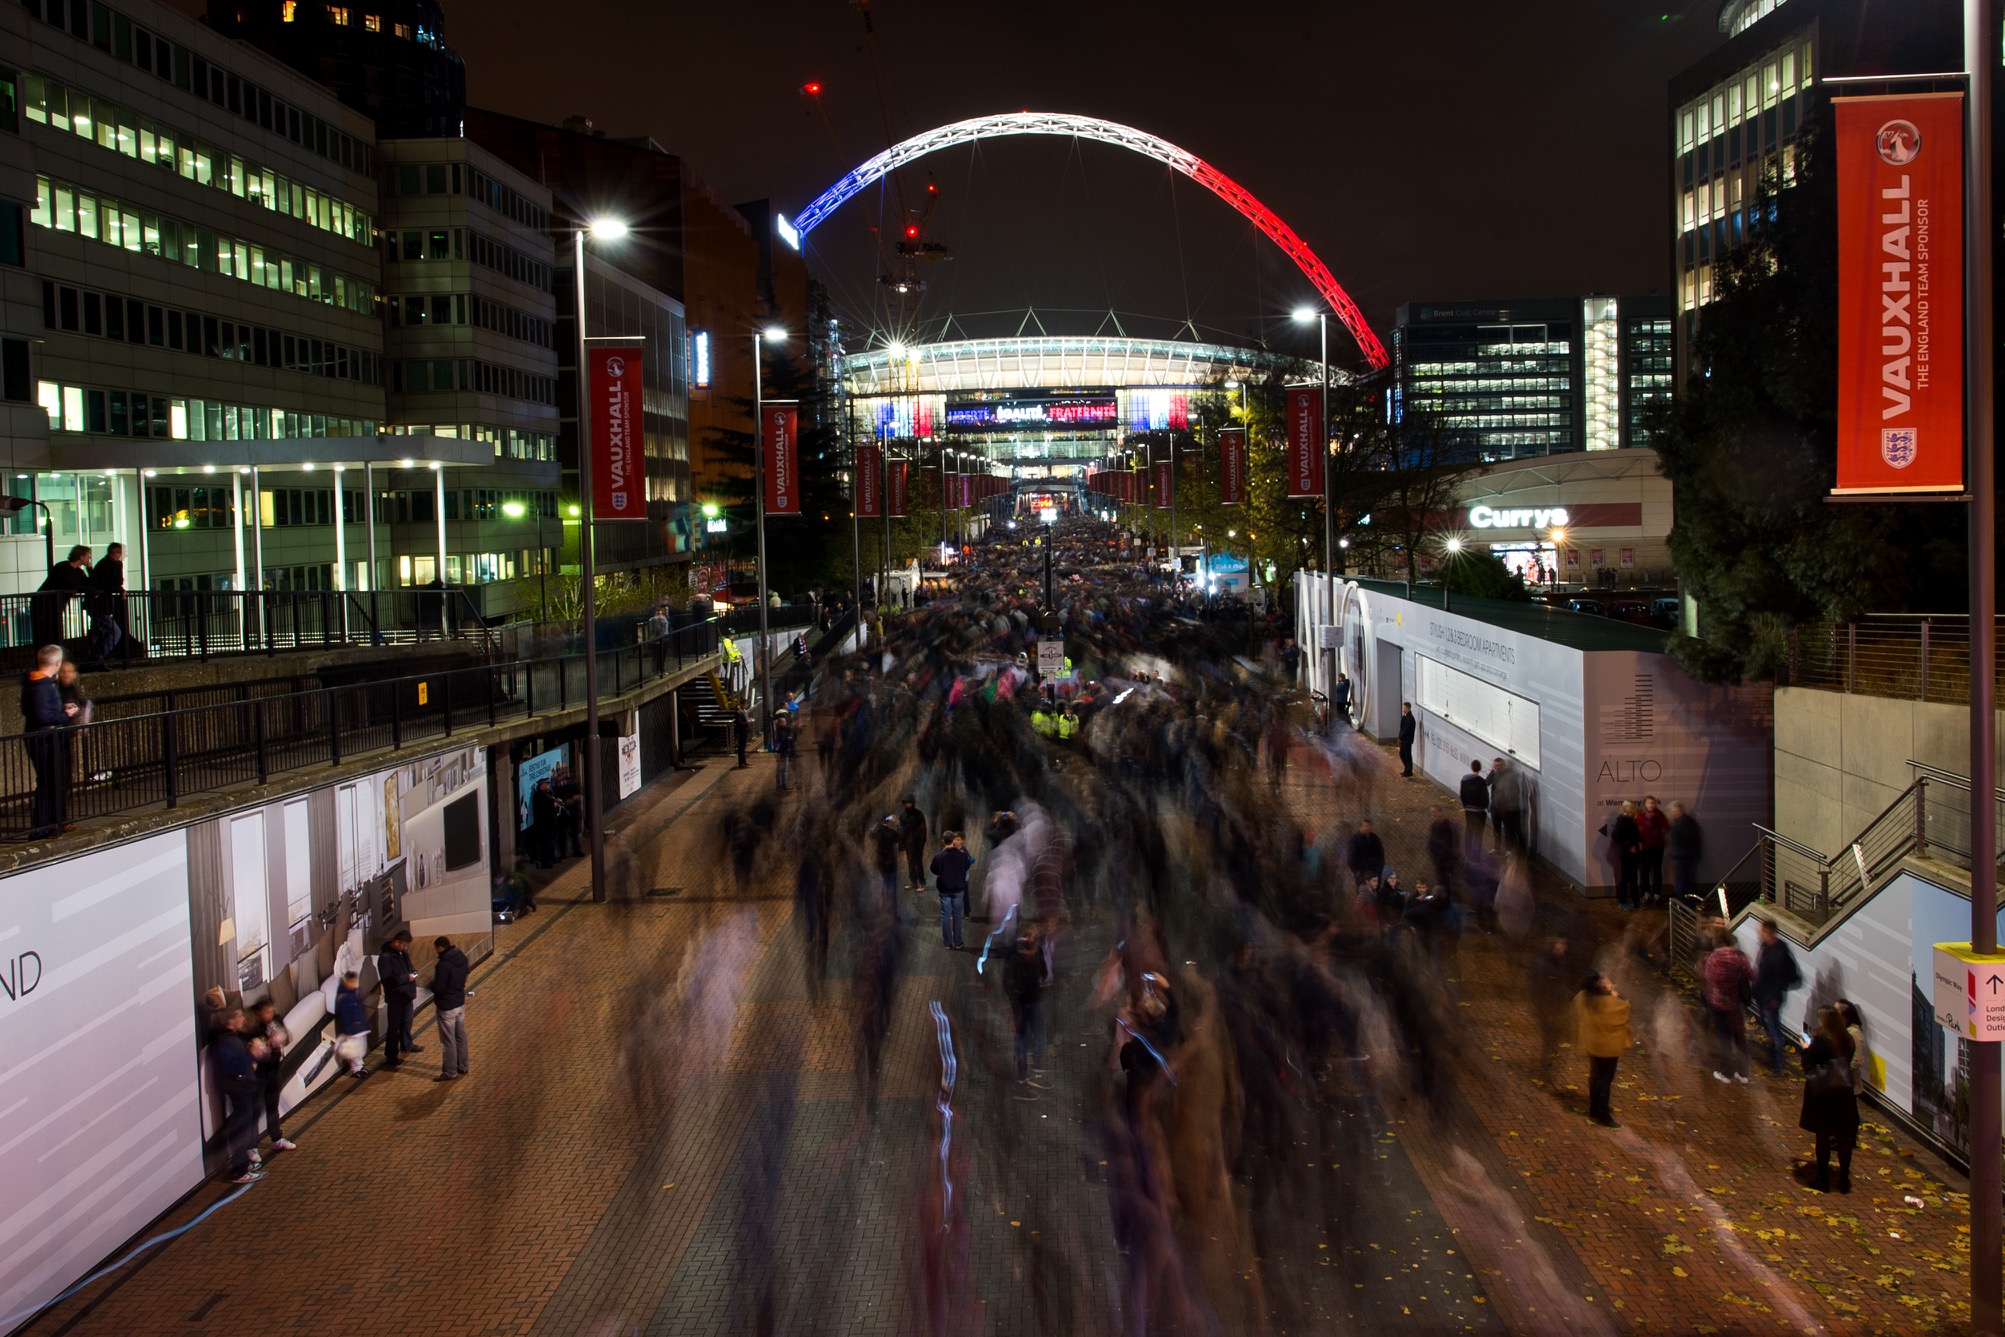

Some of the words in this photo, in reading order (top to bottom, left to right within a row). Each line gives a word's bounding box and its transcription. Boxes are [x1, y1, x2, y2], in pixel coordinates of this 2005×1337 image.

[1917, 198, 1929, 260] SPONSOR
[1881, 174, 1912, 420] VAUXHALL
[1917, 263, 1929, 299] TEAM
[1433, 309, 1454, 317] Brent
[1917, 300, 1929, 358] ENGLAND
[1917, 364, 1929, 390] THE
[609, 380, 624, 489] VAUXHALL
[1299, 409, 1309, 478] VAUXHALL
[775, 426, 786, 495] VAUXHALL
[864, 458, 872, 504] VAUXHALL
[1228, 445, 1237, 492] VAUXHALL
[1469, 505, 1569, 529] Currys
[1457, 630, 1482, 652] BEDROOM
[1482, 638, 1516, 665] APARTMENTS
[1597, 760, 1662, 782] ALTO
[1935, 972, 1953, 987] Olympic
[1953, 981, 1963, 993] Way
